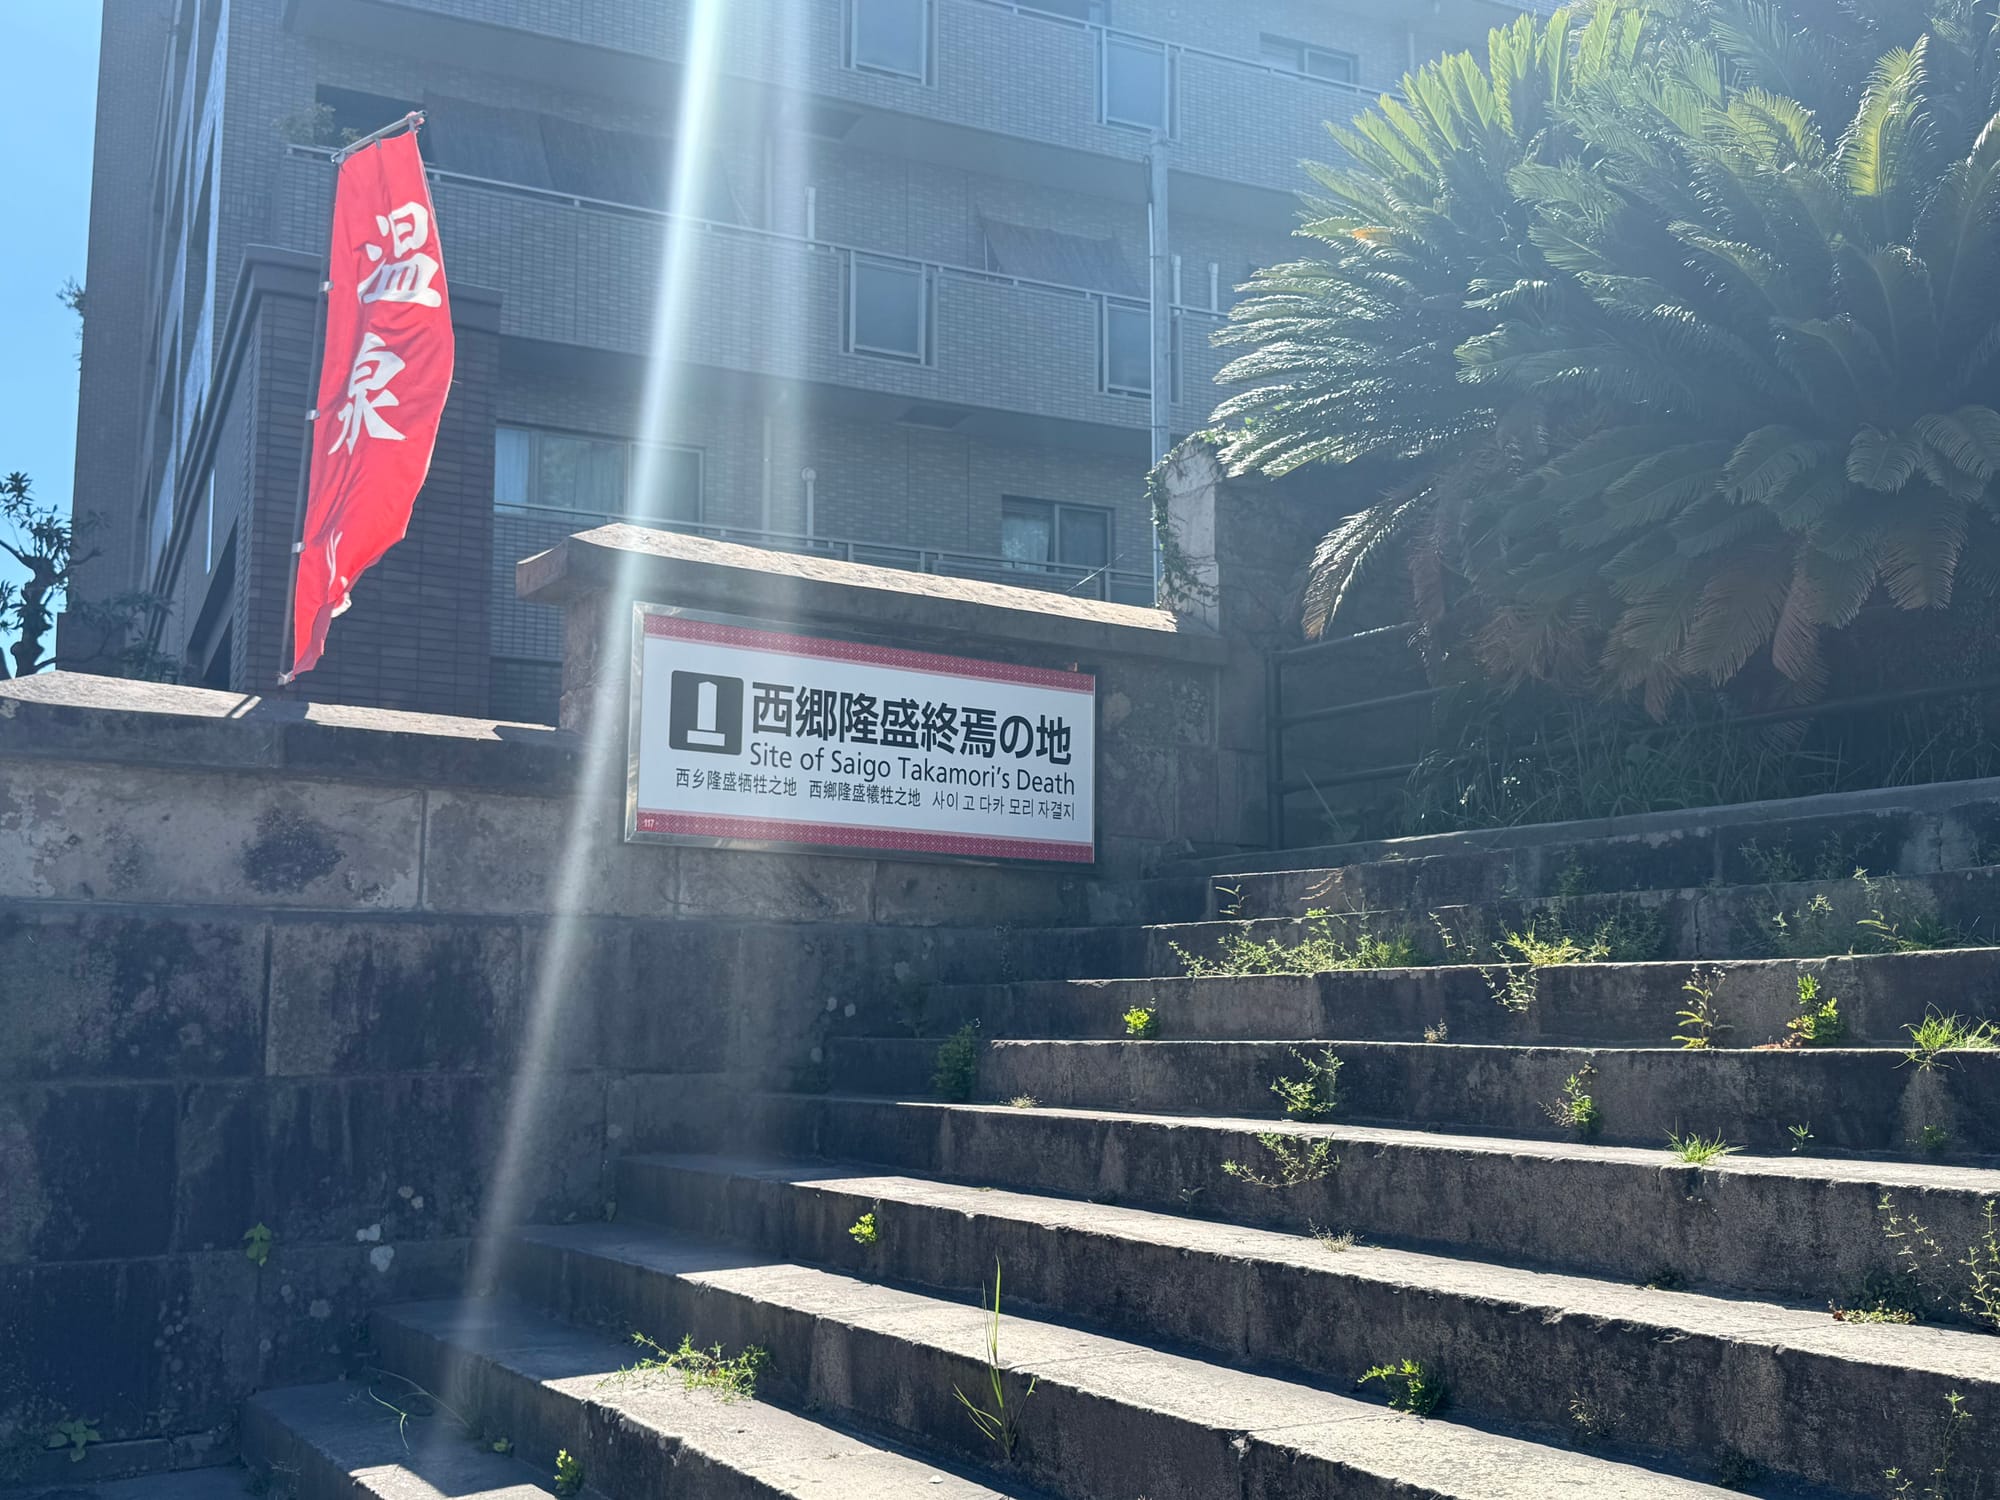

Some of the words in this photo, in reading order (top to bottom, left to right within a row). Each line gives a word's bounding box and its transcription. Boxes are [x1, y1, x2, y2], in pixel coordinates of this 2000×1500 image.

[328, 201, 442, 455] 温泉
[752, 680, 1072, 765] 西郷隆盛終焉の地
[676, 768, 797, 796] 西乡隆盛牺牲之地
[750, 742, 792, 769] Site
[800, 747, 825, 772] of
[831, 751, 891, 782] Saigo
[1017, 769, 1075, 795] Death
[1038, 800, 1075, 821] 자결지
